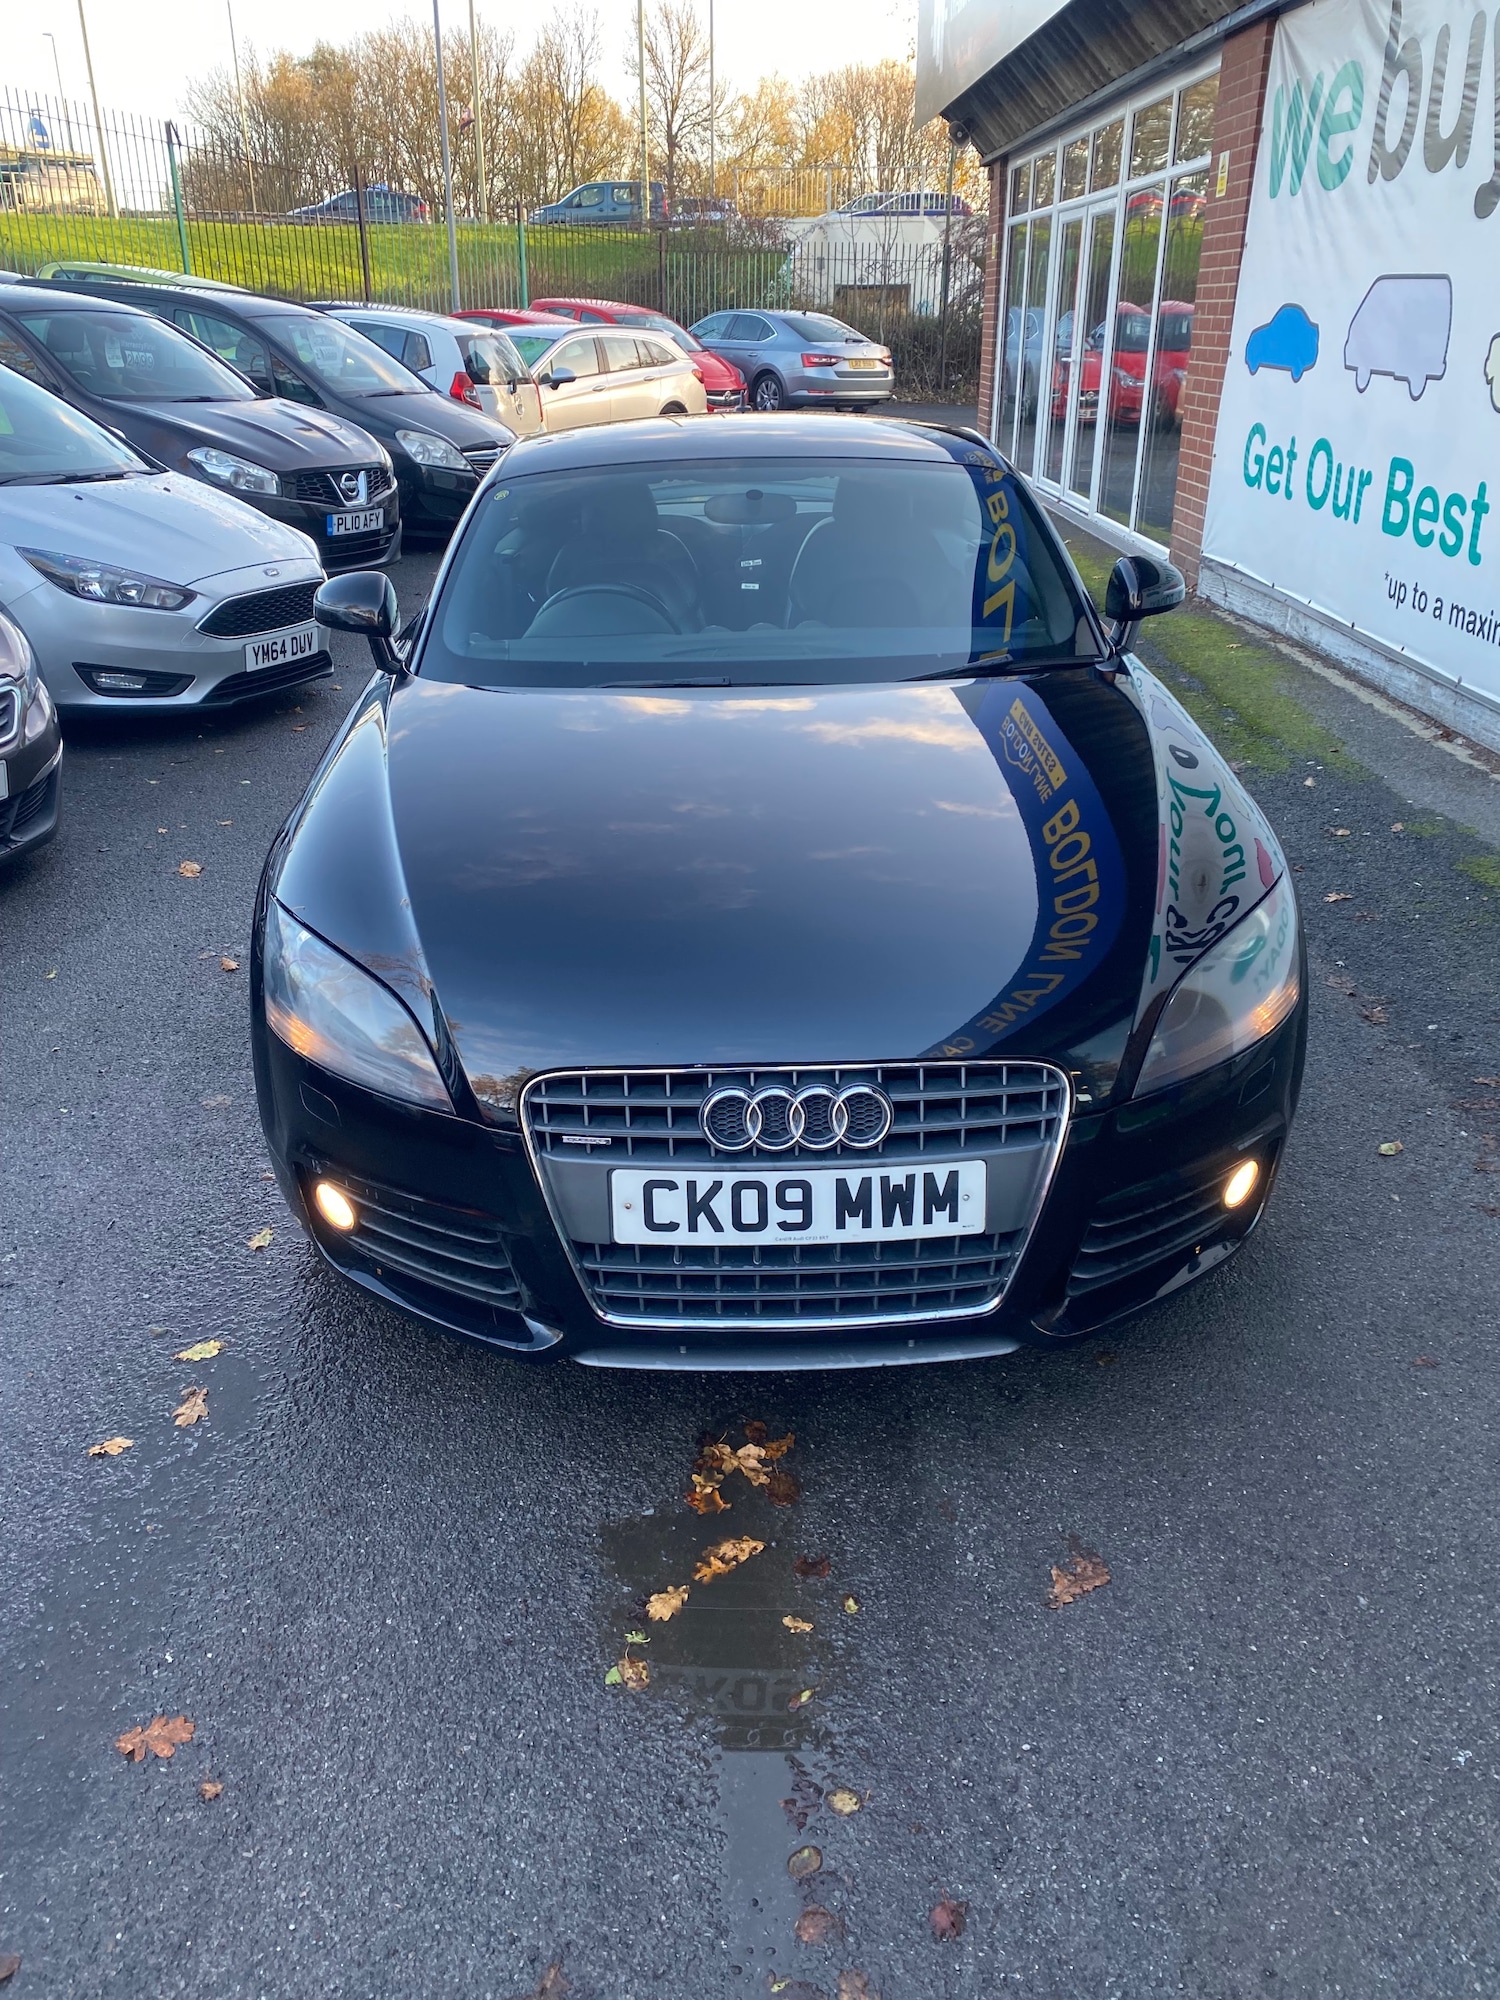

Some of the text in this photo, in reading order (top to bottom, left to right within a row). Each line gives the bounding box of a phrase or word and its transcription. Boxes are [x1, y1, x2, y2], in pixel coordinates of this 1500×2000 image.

[1243, 422, 1490, 566] Get Our Best
[337, 511, 380, 532] PL10 AFY
[1412, 581, 1428, 613] to
[1432, 596, 1444, 621] a
[252, 631, 313, 666] YM64 DUV
[642, 1170, 960, 1233] CK09 MWM
